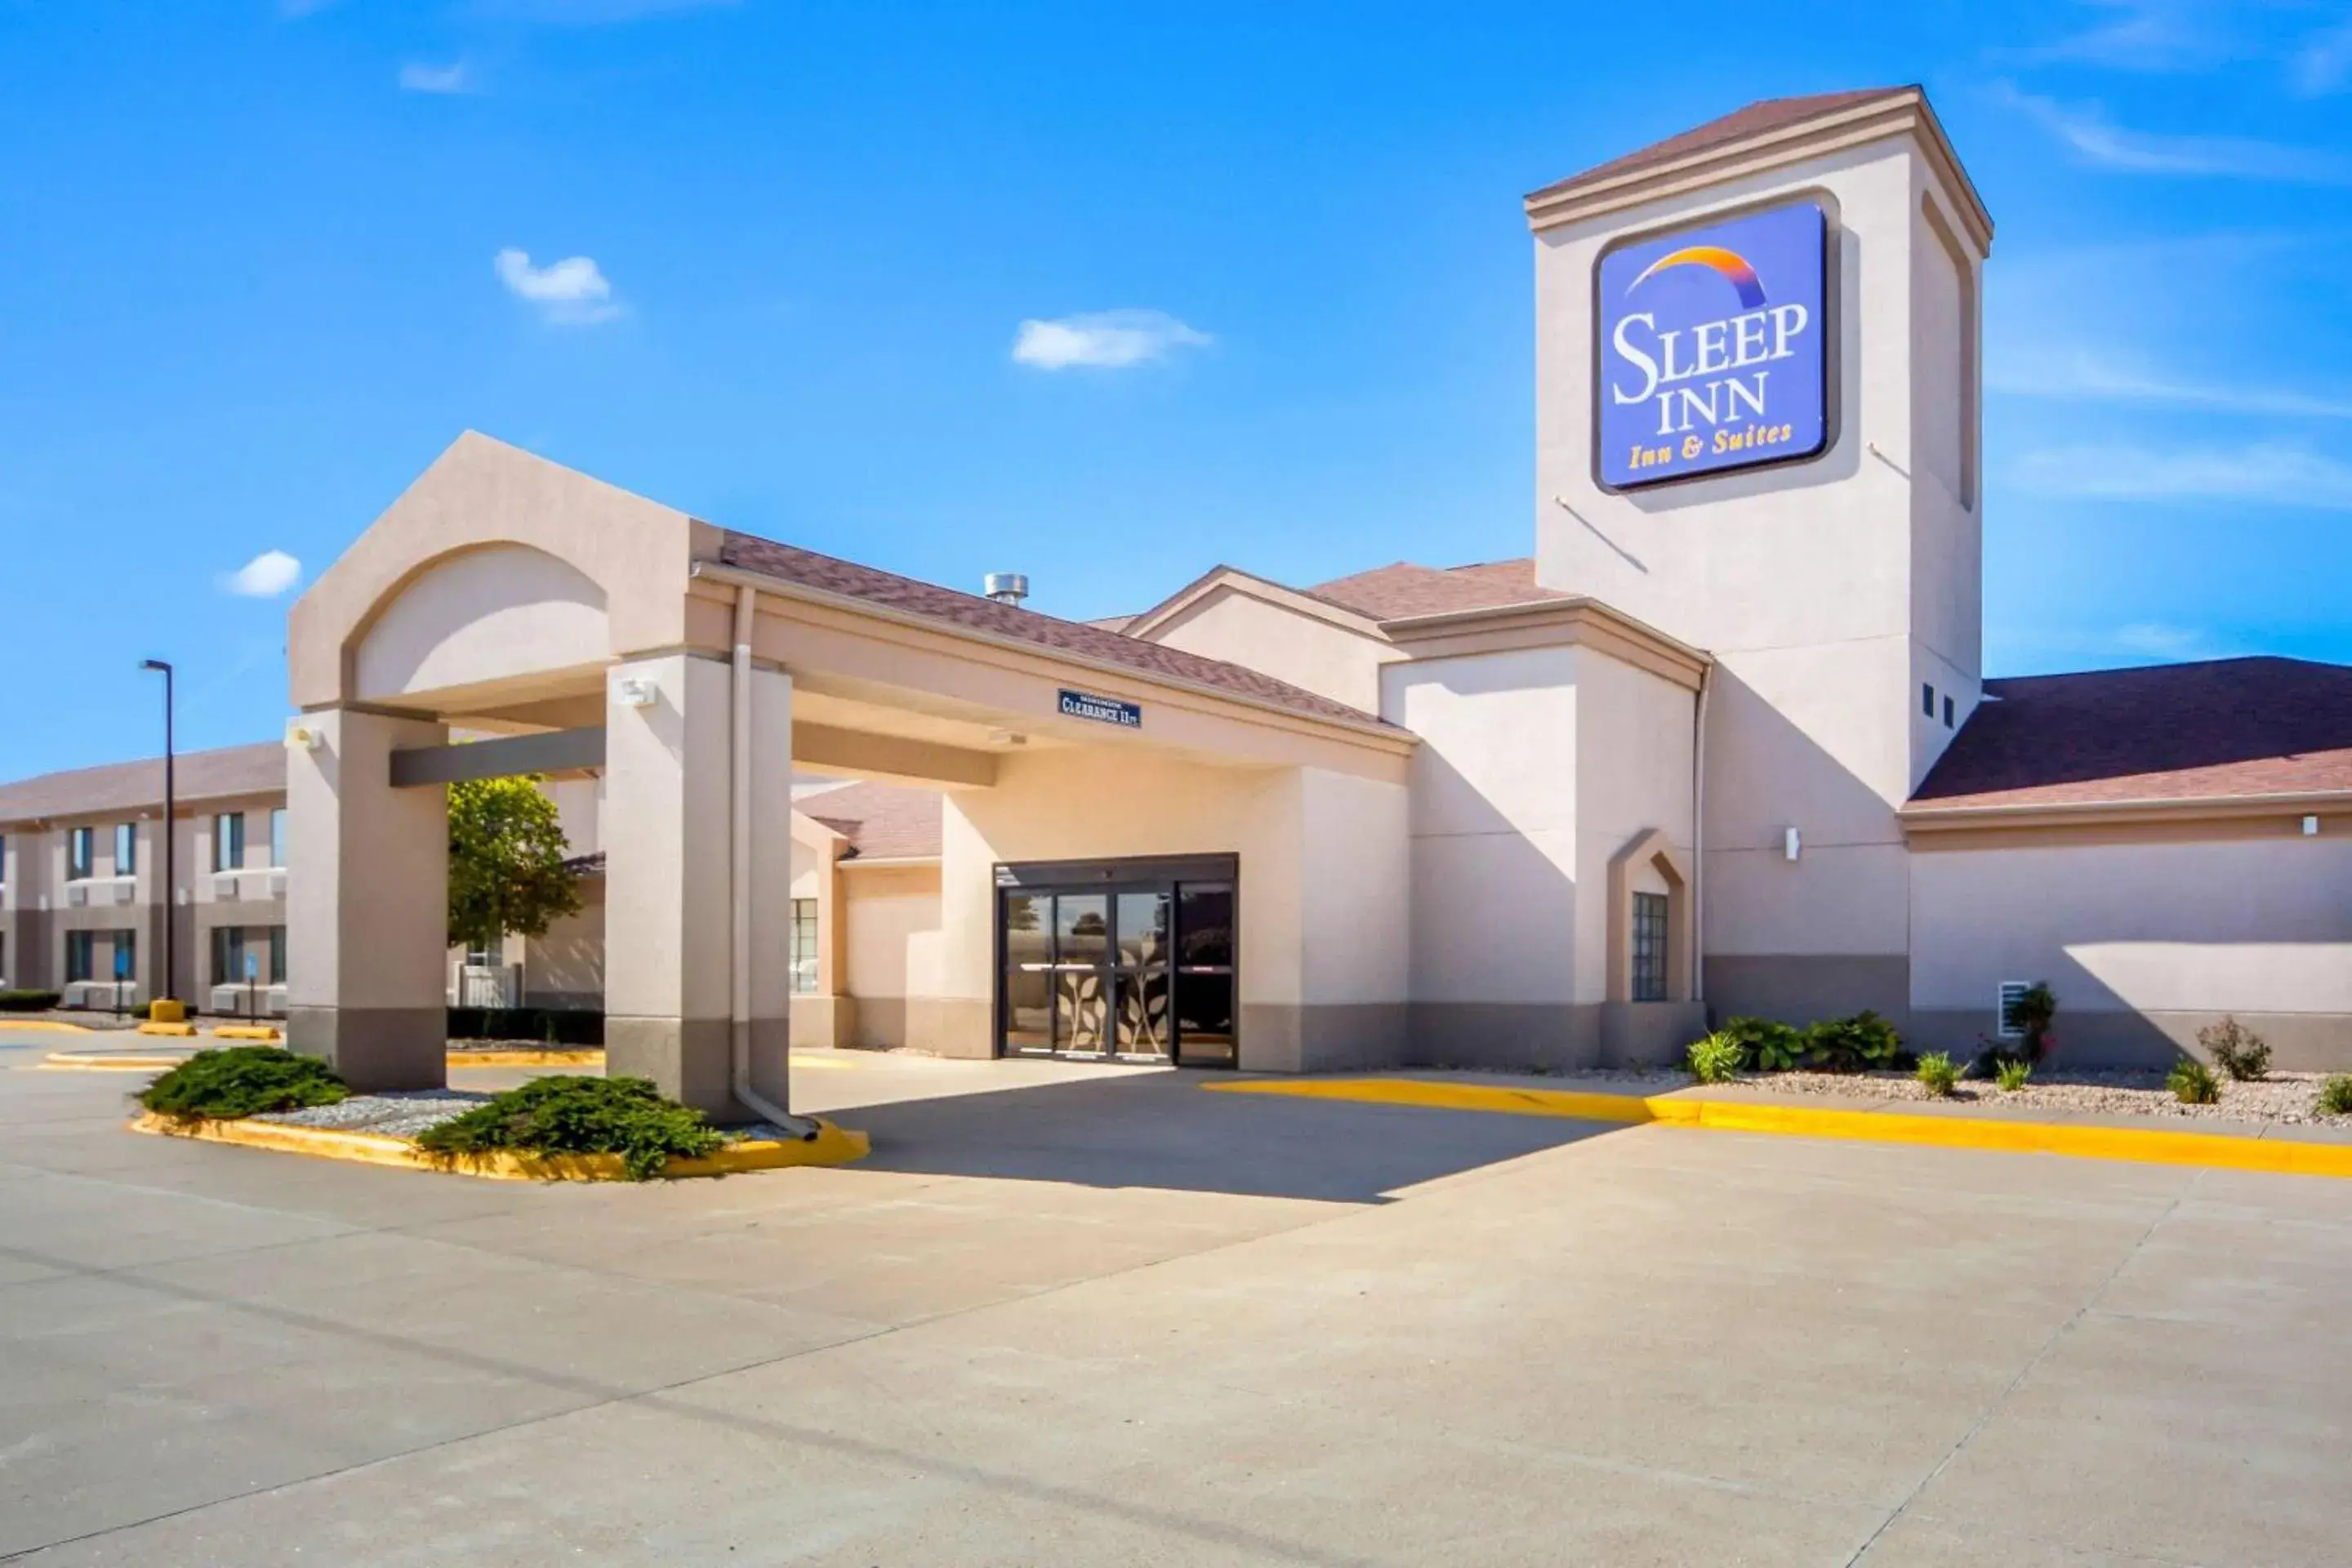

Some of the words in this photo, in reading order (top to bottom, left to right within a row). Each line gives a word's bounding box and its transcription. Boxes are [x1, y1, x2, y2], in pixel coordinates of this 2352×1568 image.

[1613, 303, 1808, 405] SLEEP
[1656, 371, 1770, 435] INN
[1628, 445, 1672, 470] Inn
[1682, 434, 1705, 459] &
[1711, 423, 1793, 455] Suites
[1062, 697, 1118, 720] CLEARANCE
